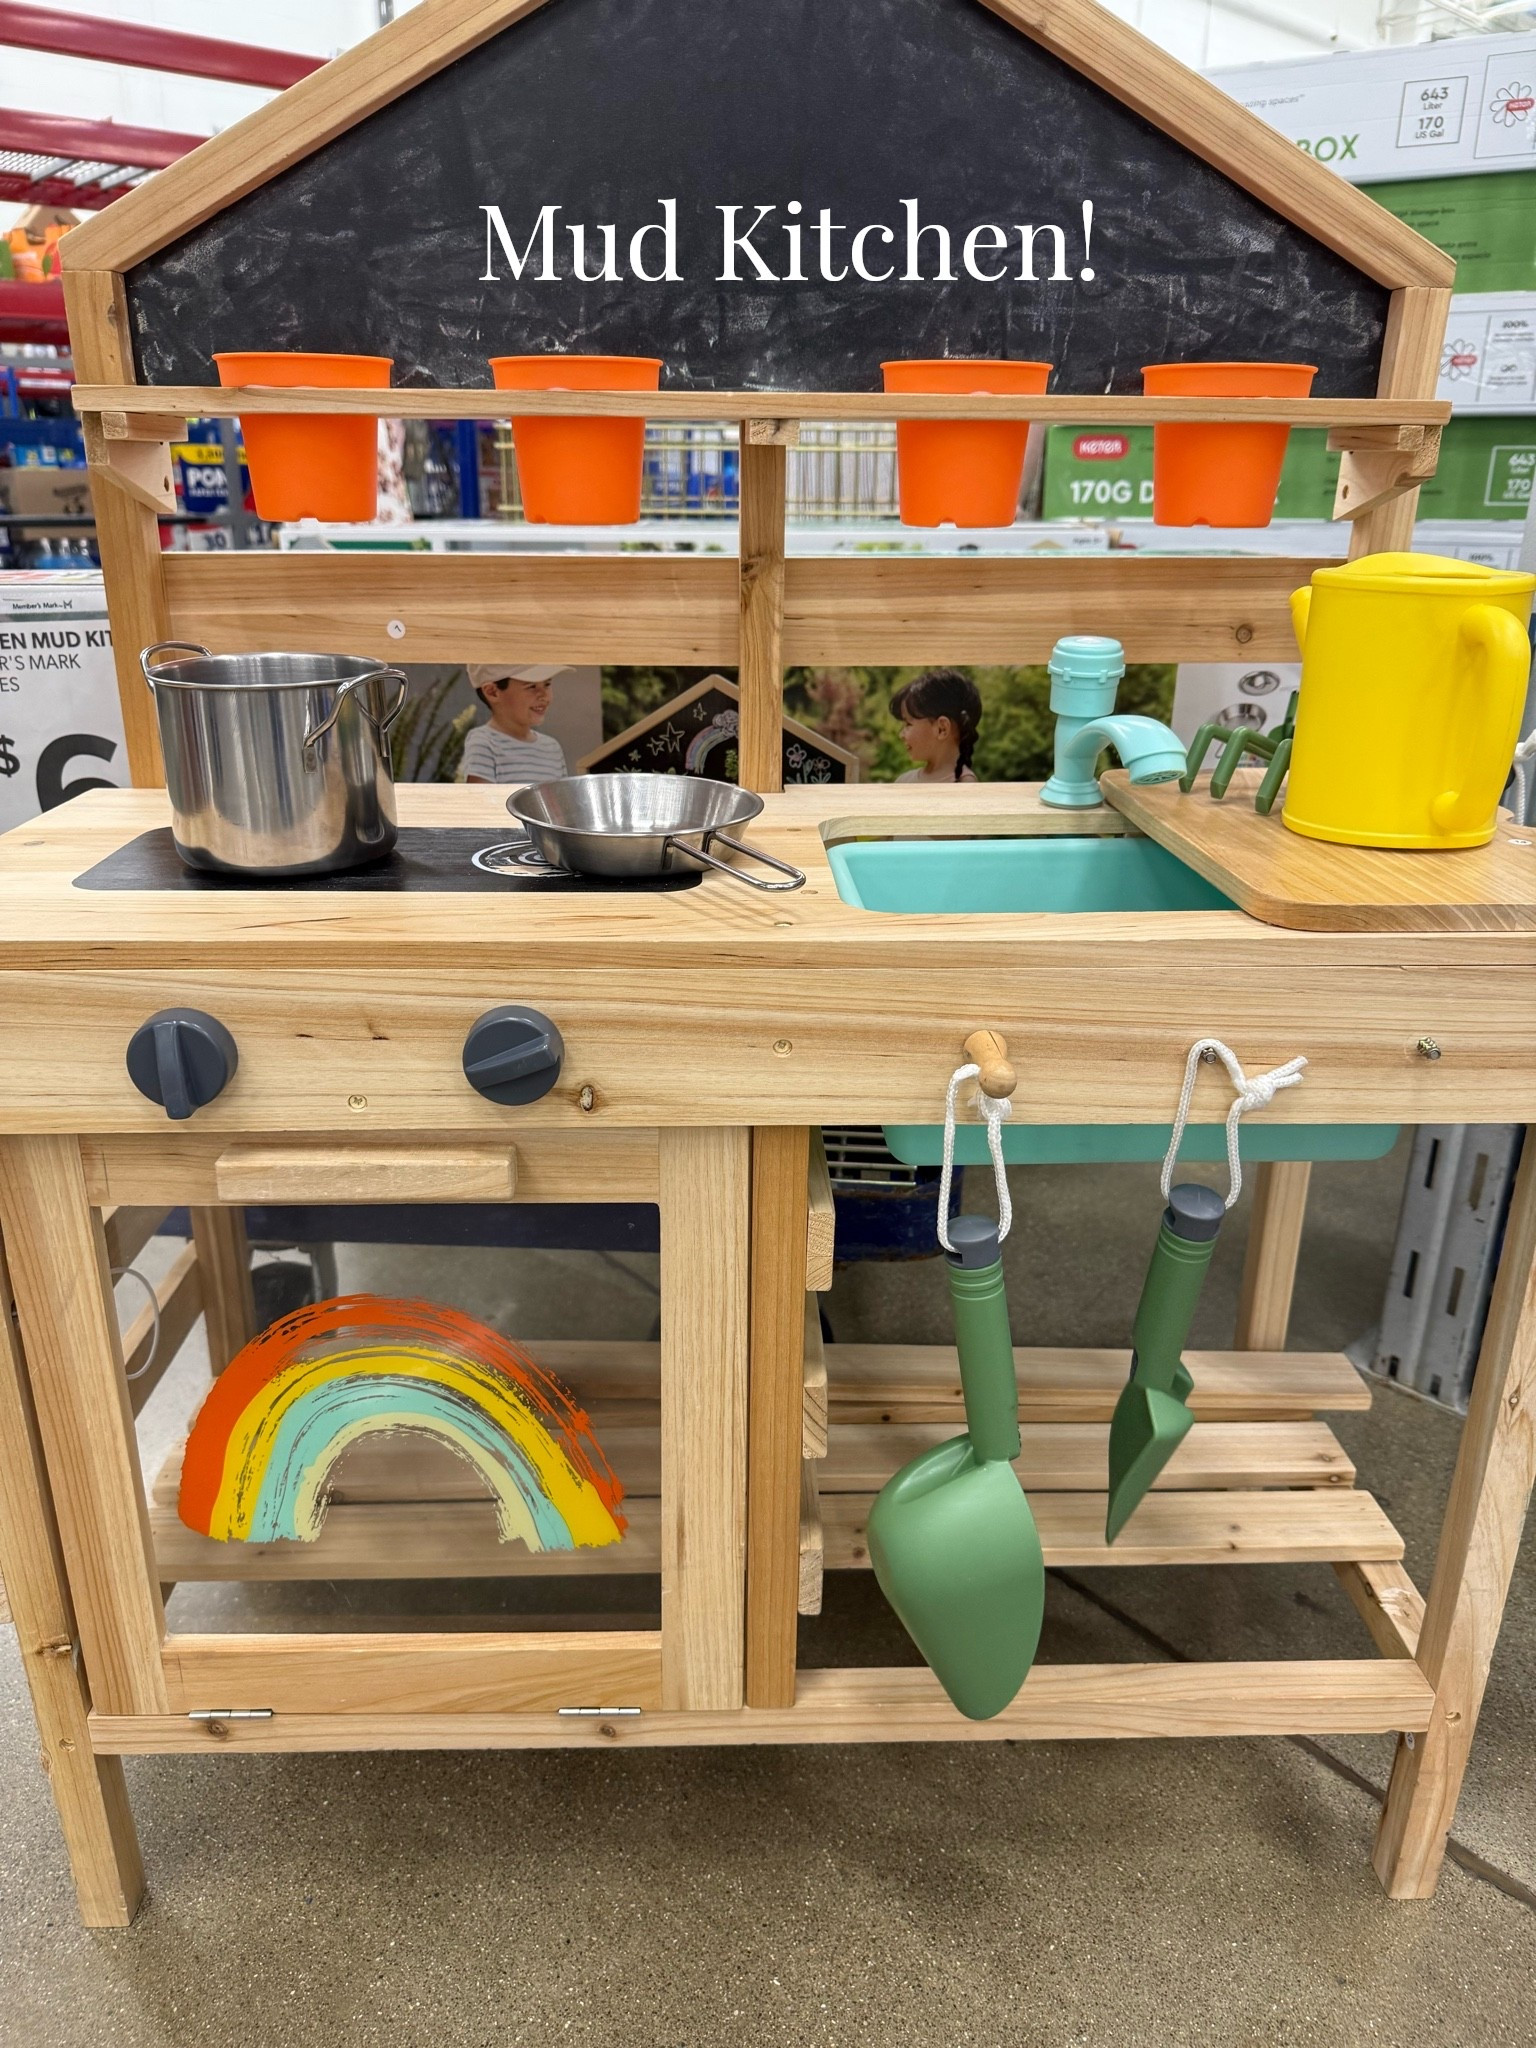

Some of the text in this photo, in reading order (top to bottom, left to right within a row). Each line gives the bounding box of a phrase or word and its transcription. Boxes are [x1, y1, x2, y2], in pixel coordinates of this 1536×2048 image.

[1420, 86, 1450, 101] 643
[1423, 102, 1443, 111] Liter
[1418, 116, 1444, 130] 170
[1415, 129, 1445, 139] US Gal
[1069, 479, 1133, 505] 170G
[12, 602, 41, 610] Member's
[0, 632, 27, 650] EN
[31, 630, 81, 650] MUD
[29, 653, 82, 670] MARK
